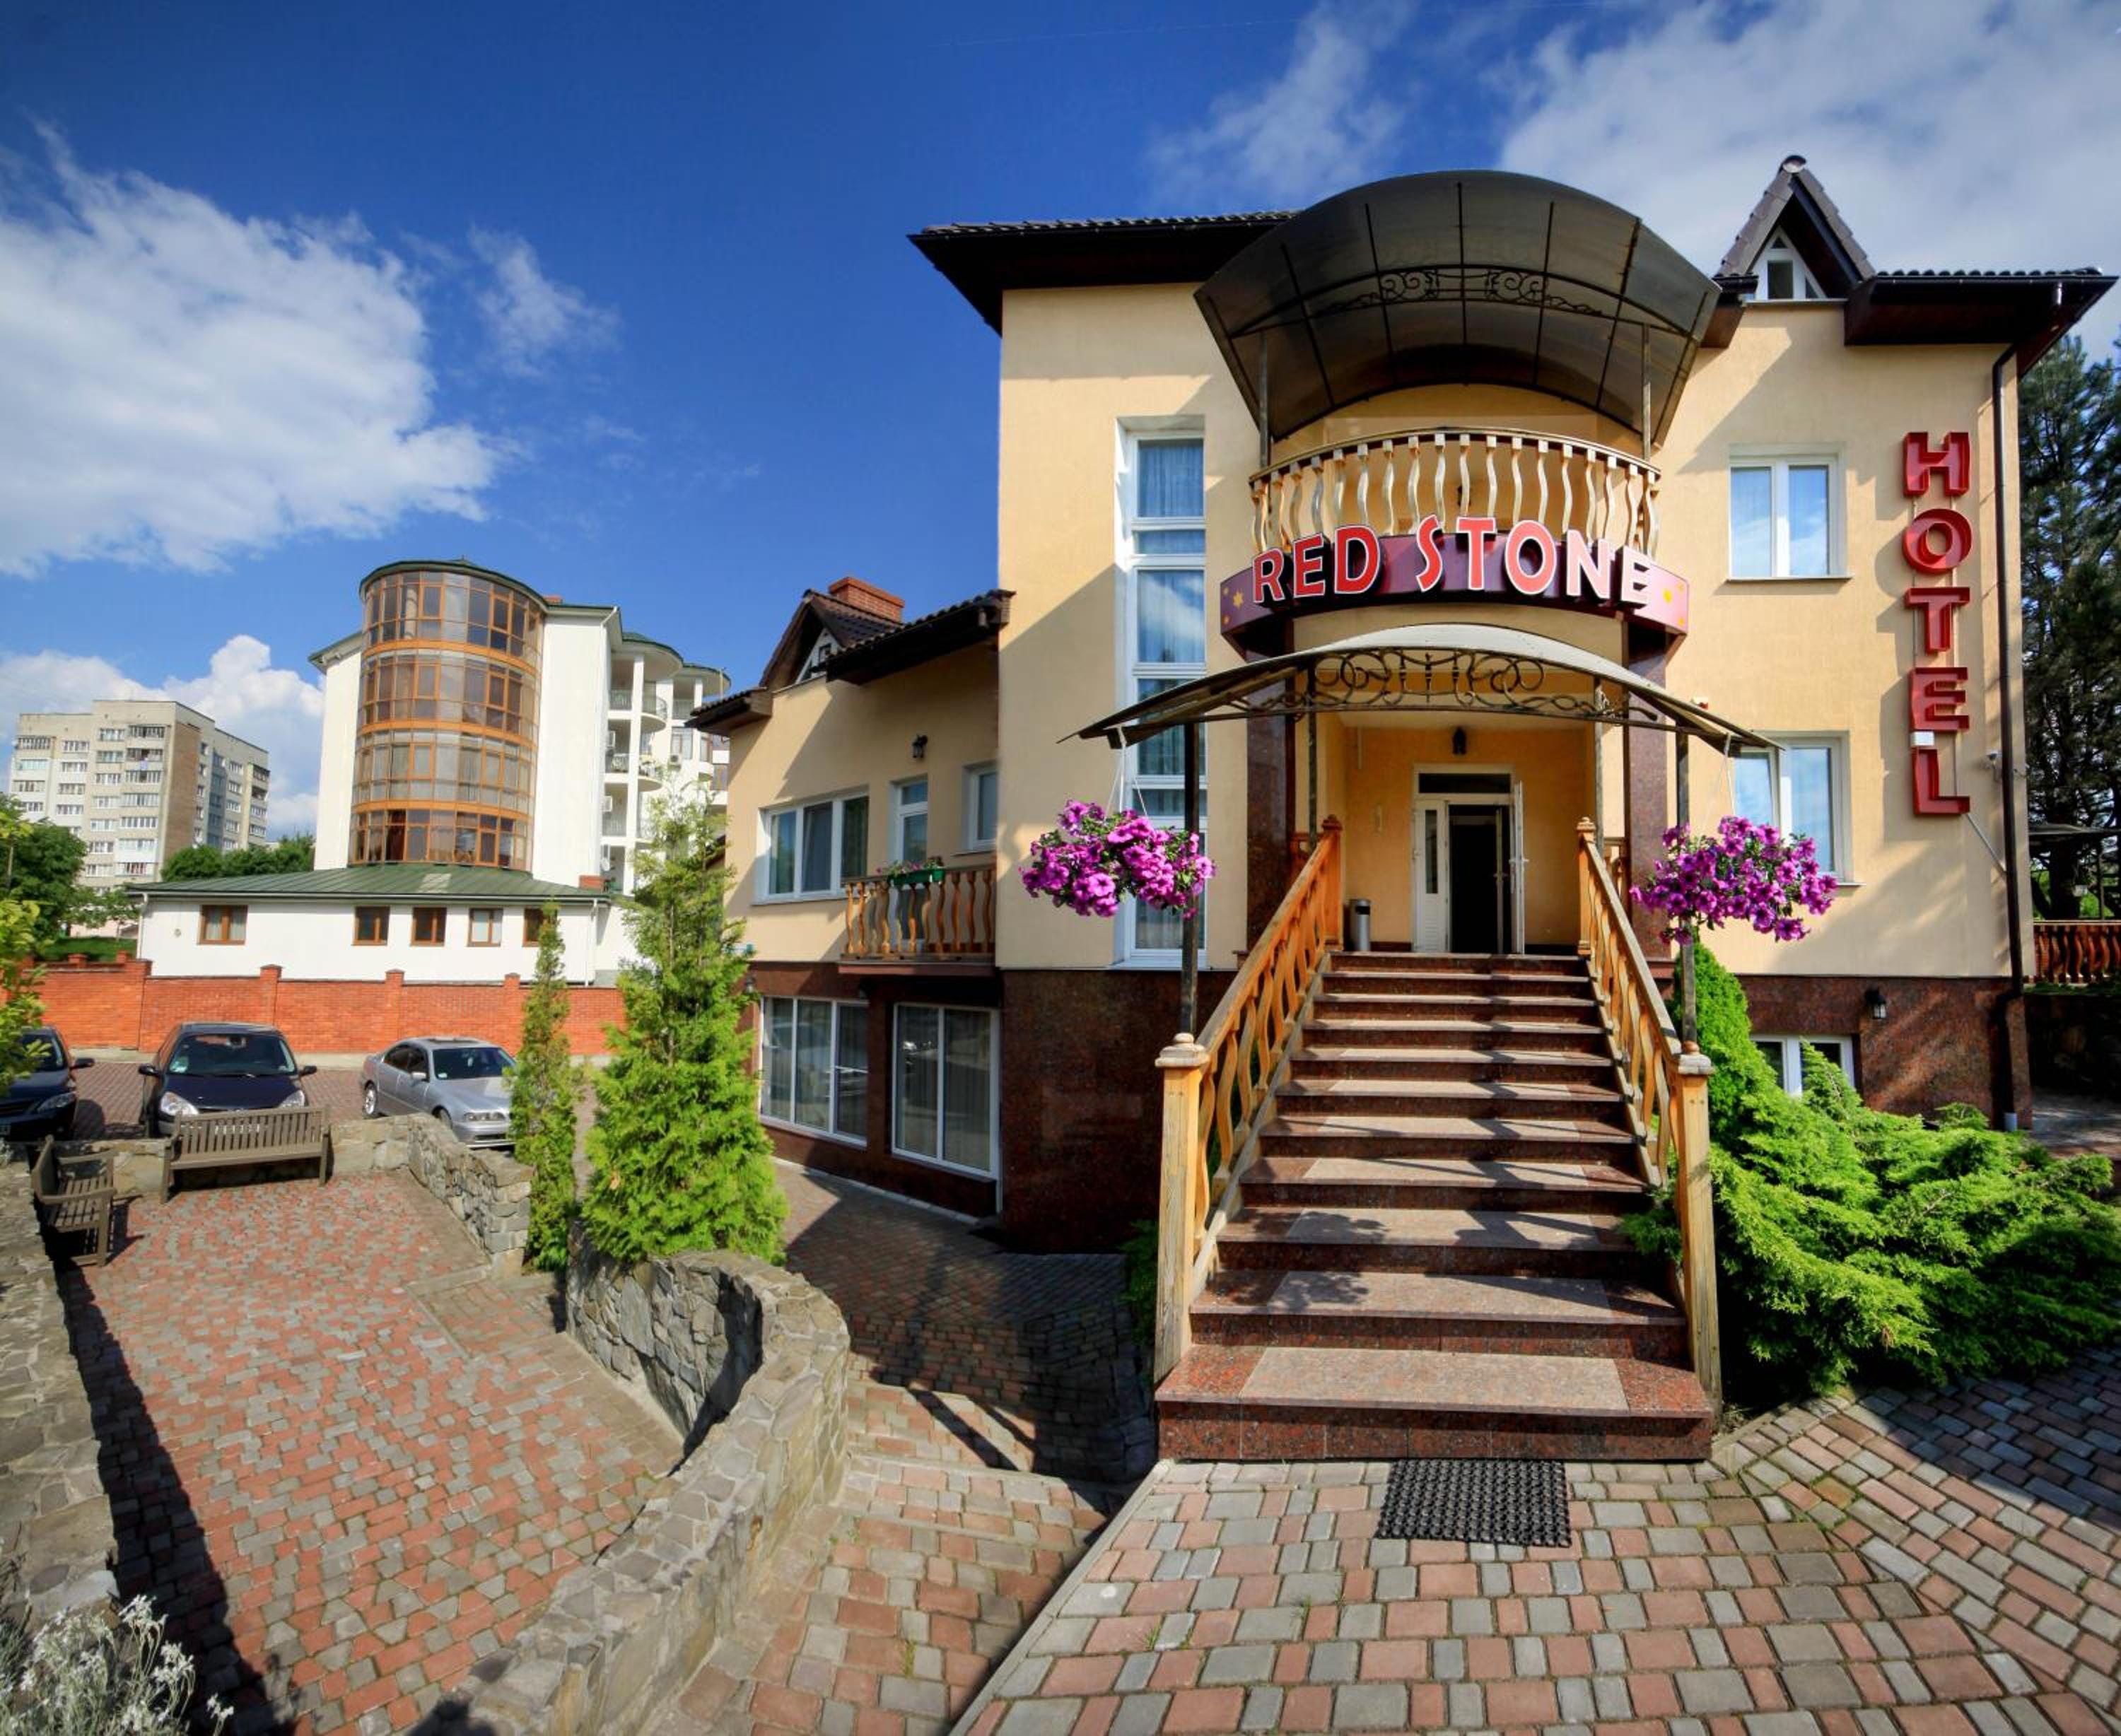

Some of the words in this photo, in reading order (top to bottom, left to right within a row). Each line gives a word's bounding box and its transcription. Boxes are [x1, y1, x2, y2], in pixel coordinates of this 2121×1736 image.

[1252, 524, 1380, 603] RED
[1415, 514, 1653, 603] STONE
[1902, 432, 1972, 815] HOTEL
